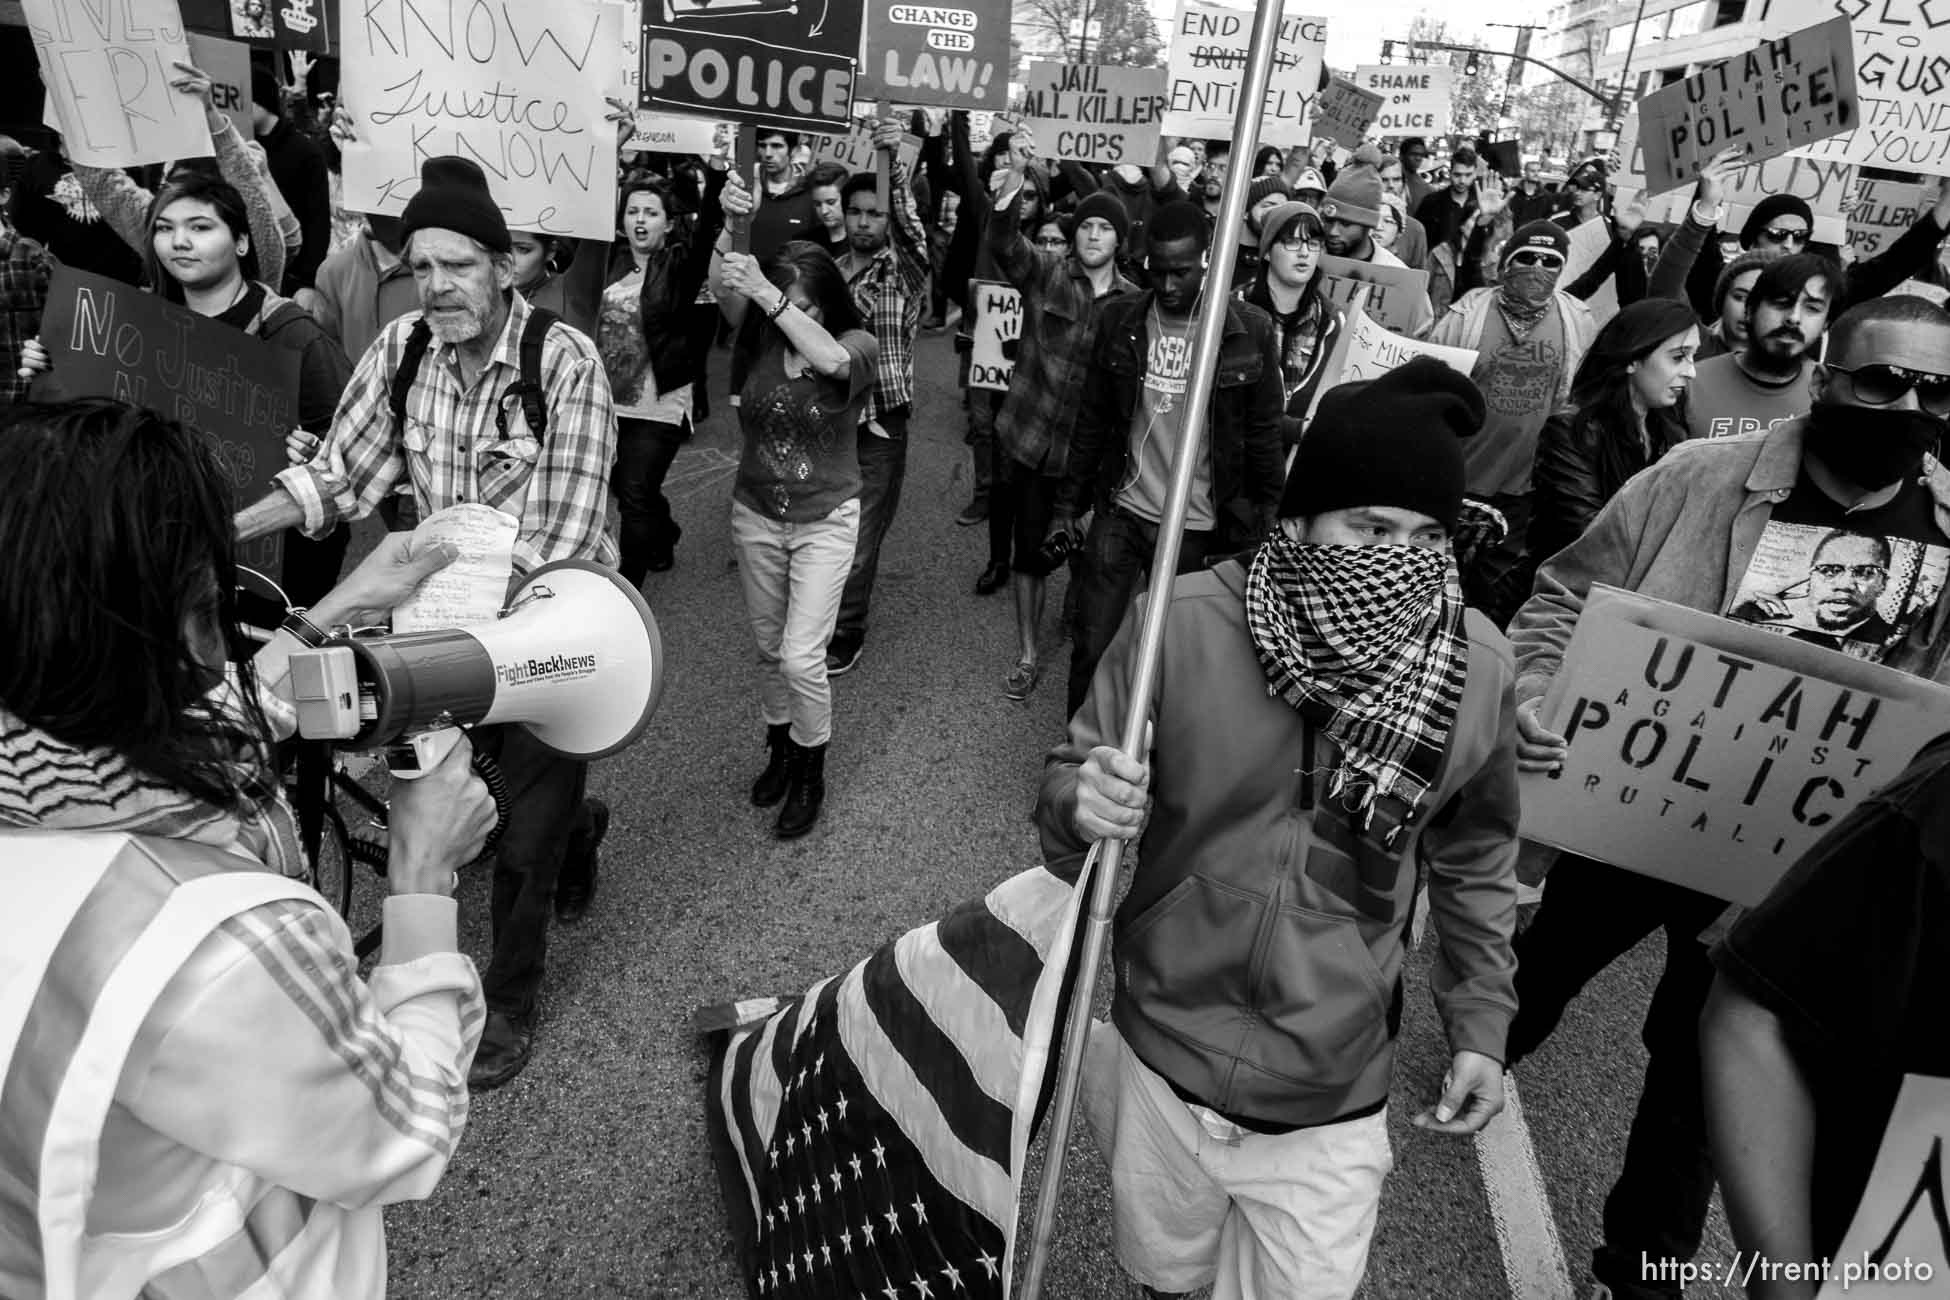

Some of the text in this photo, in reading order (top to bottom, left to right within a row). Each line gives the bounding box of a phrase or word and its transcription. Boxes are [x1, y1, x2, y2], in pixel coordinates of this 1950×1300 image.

[891, 7, 974, 27] CHANGE
[1182, 11, 1240, 37] END
[363, 0, 600, 71] KNOW
[931, 32, 969, 48] THE
[1856, 30, 1920, 47] TO
[649, 38, 850, 118] POLICE
[885, 49, 994, 99] LAW!
[1051, 65, 1108, 93] JAIL
[1369, 74, 1430, 89] SHAME
[1683, 37, 1792, 103] UTAH
[1858, 52, 1950, 96] GUS
[211, 84, 240, 111] ER
[370, 69, 584, 134] Justice
[1024, 90, 1069, 119] ALL
[1076, 95, 1165, 124] KILLER
[1170, 80, 1315, 126] ENTIELY
[1393, 94, 1411, 104] ON
[1670, 66, 1834, 160] POLICE
[1857, 97, 1950, 133] TAND
[1379, 113, 1434, 129] OLICE
[411, 124, 596, 191] KNOW
[818, 136, 876, 170] POLI
[1057, 131, 1125, 161] COPS
[1863, 129, 1950, 165] YOU!
[1328, 276, 1386, 310] TAH
[1147, 335, 1192, 378] ASEBA
[1644, 636, 1881, 752] UTAH
[1614, 688, 1872, 778] AGAINST
[1563, 696, 1846, 827] POLIC
[1547, 762, 1785, 855] RUTALI
